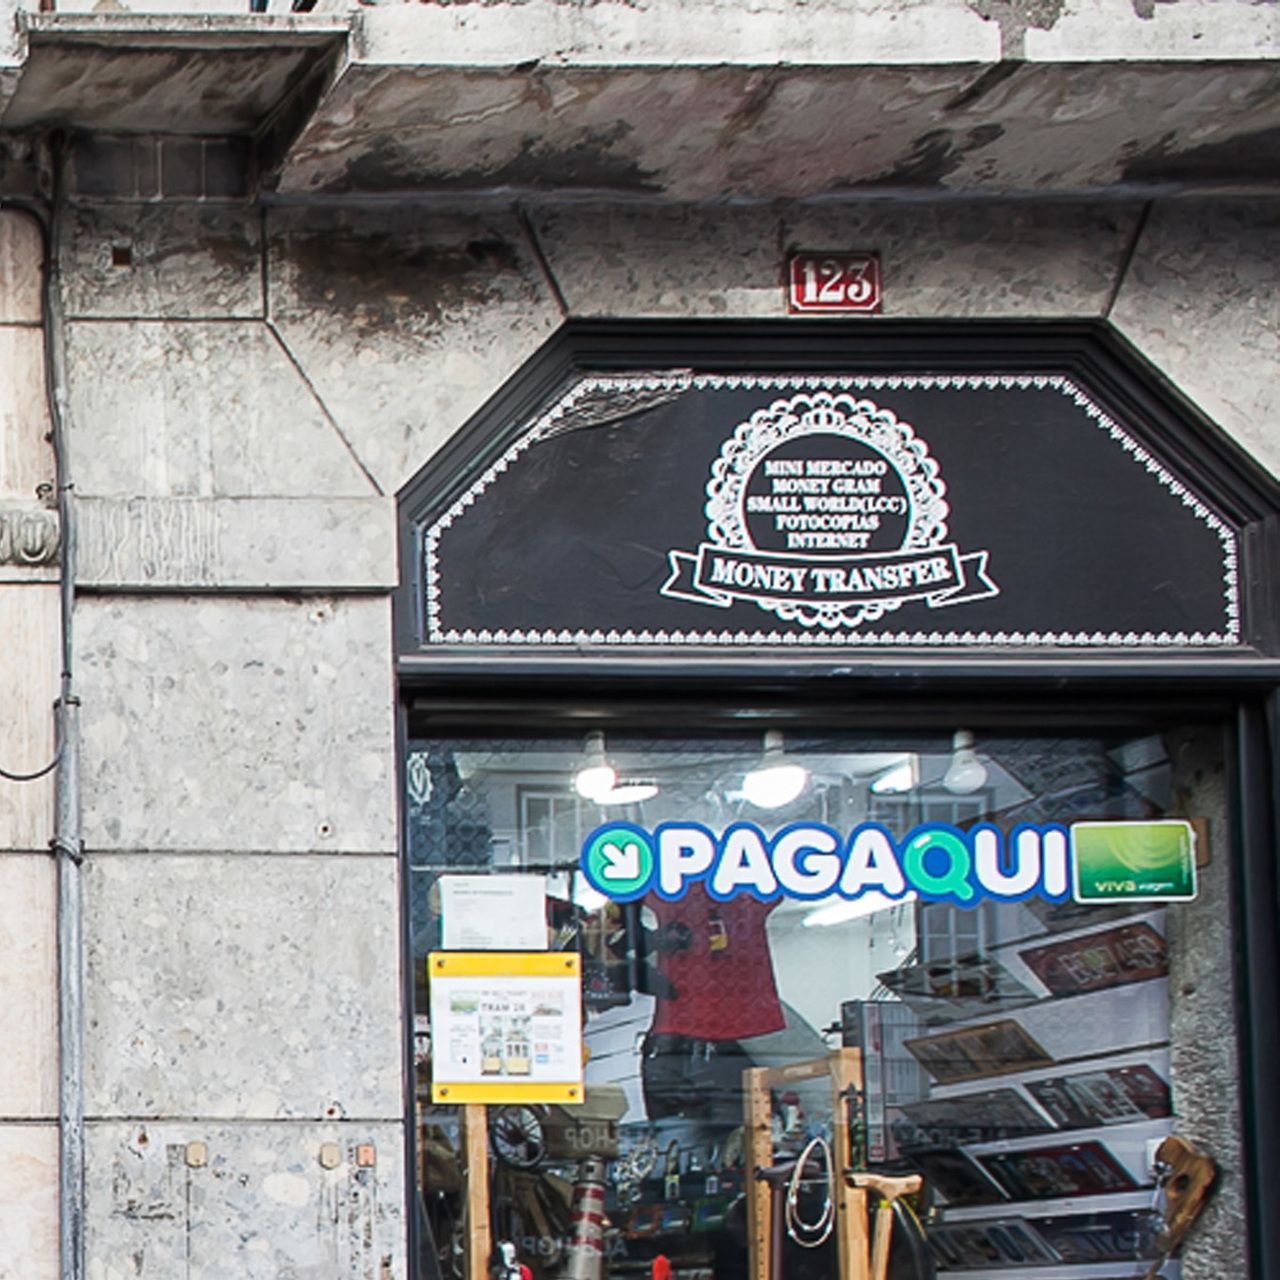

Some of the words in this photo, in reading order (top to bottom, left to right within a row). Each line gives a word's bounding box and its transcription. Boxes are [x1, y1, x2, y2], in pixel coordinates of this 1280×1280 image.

[803, 260, 872, 303] 123
[765, 461, 803, 476] MINI
[807, 461, 886, 476] MERCADO
[773, 479, 830, 494] MONEY
[832, 479, 881, 494] GRAM
[747, 497, 801, 512] SMALL
[788, 533, 870, 548] INTERNET
[711, 558, 807, 592] MONEY
[810, 558, 951, 592] TRANSFER
[660, 828, 1067, 900] PAGAQUI
